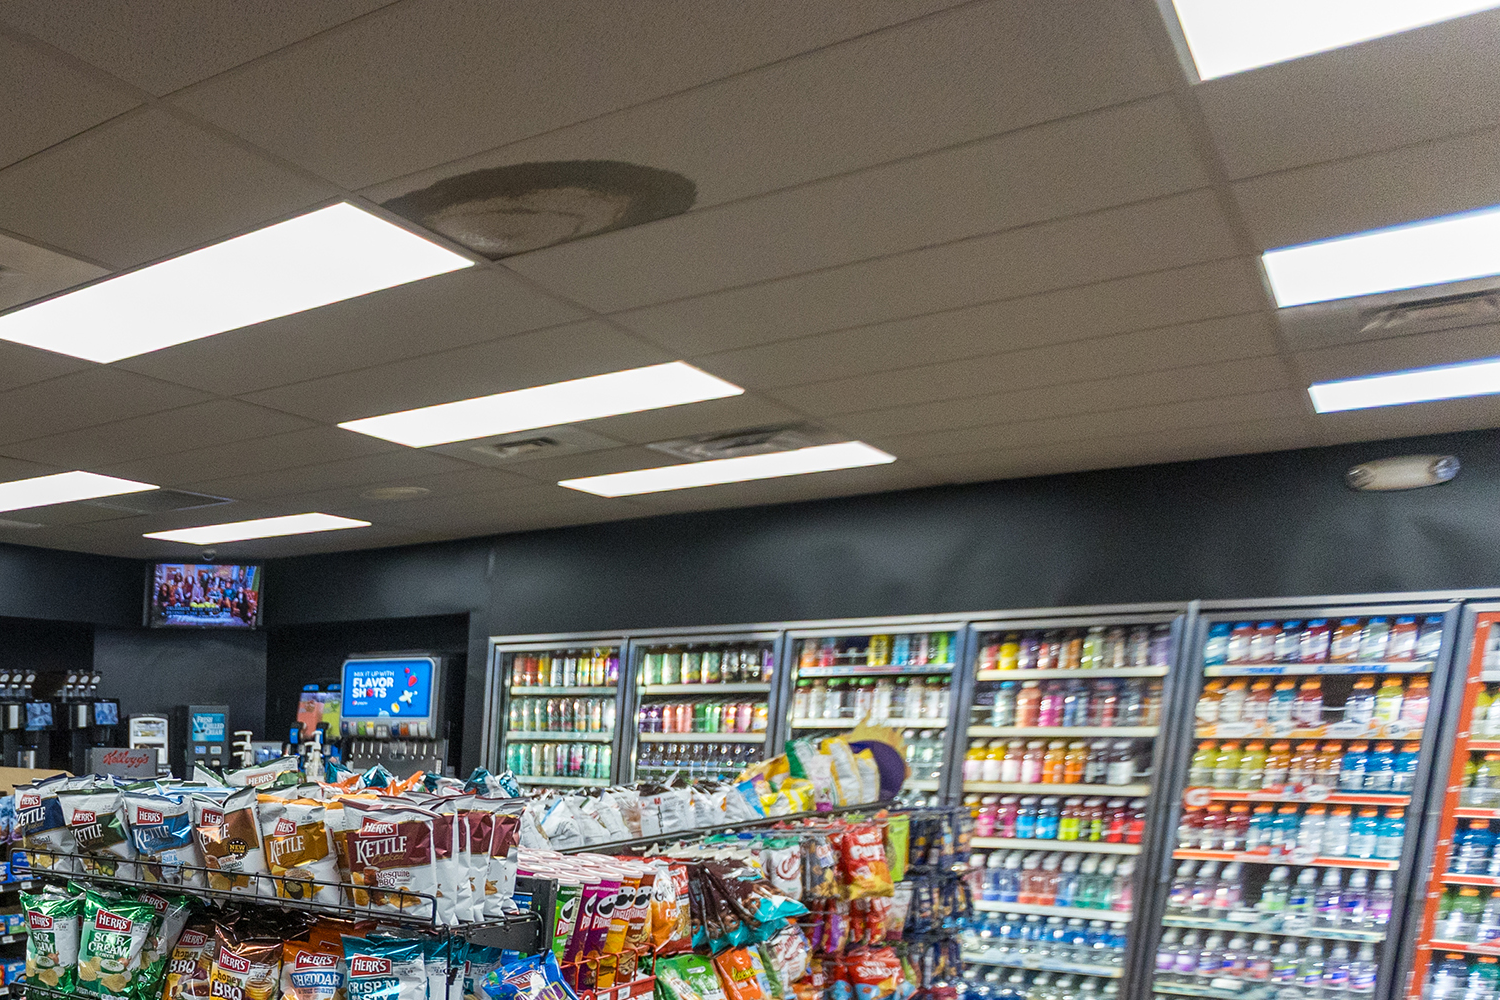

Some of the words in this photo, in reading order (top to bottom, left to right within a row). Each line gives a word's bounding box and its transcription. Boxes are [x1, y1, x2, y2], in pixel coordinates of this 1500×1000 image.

[353, 677, 395, 688] FLAVOR
[103, 750, 150, 768] Kellogg's
[248, 773, 274, 786] HERR'S
[73, 810, 95, 823] HERR'S
[138, 810, 161, 823] HERR'S
[364, 820, 395, 835] HERR'S
[72, 824, 103, 848] KETTLE
[133, 824, 170, 849] KETTLE
[270, 836, 304, 865] KETTLE
[355, 836, 407, 866] KETTLE
[371, 852, 405, 867] Cooked
[376, 869, 411, 880] Mesquite
[378, 877, 396, 888] BBQ
[98, 912, 129, 931] HERR'S
[182, 932, 206, 946] HERR'S
[88, 942, 128, 957] CREAM
[169, 958, 196, 975] BBQ
[221, 952, 248, 971] HERR'S
[299, 955, 333, 967] HERR'S
[354, 959, 387, 973] HERR'S
[217, 970, 243, 984] honey
[292, 973, 341, 987] CHEDDAR
[211, 981, 242, 1000] BBQ
